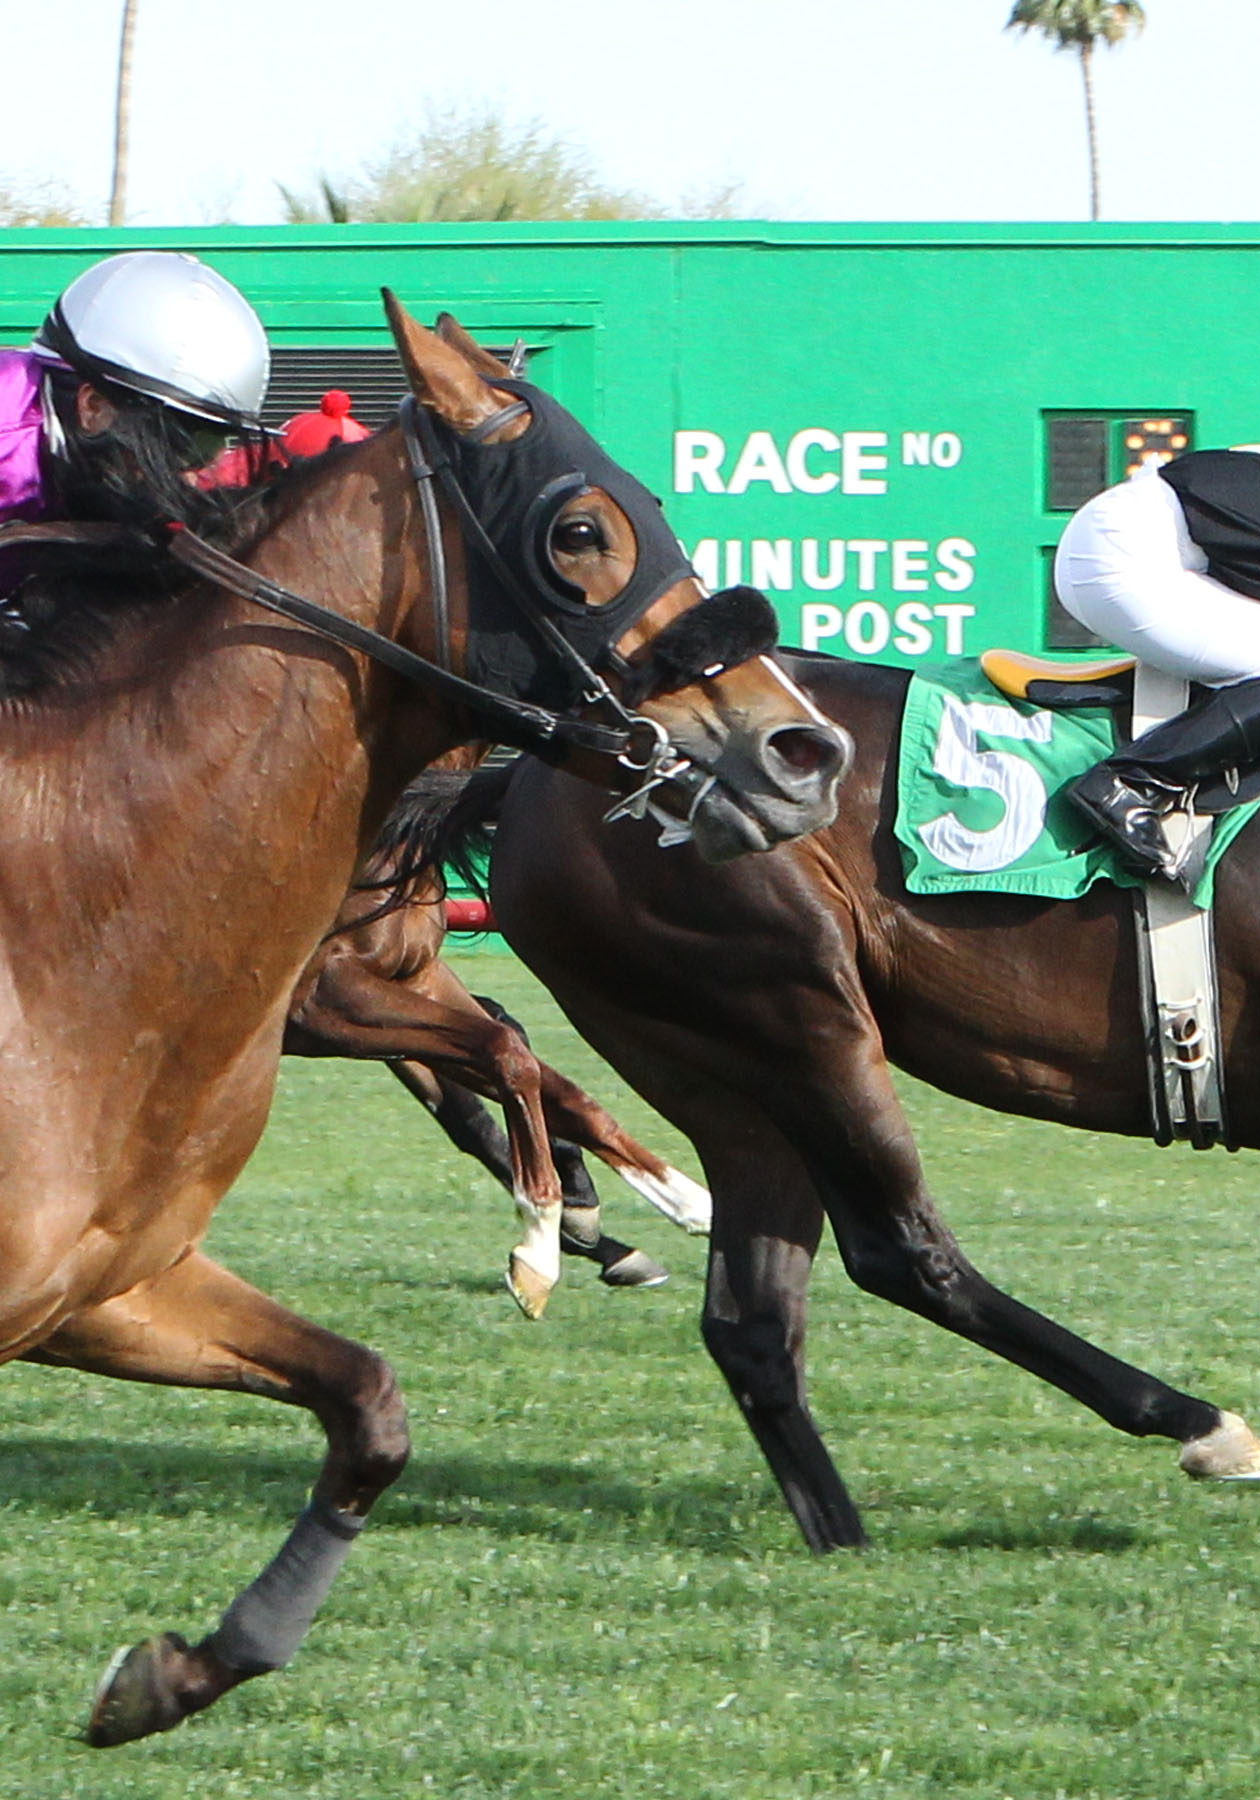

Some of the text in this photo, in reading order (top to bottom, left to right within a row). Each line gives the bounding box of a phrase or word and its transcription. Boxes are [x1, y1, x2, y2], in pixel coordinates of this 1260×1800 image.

[673, 427, 962, 495] RACE NO
[801, 600, 976, 656] POST
[918, 693, 1053, 872] 5
